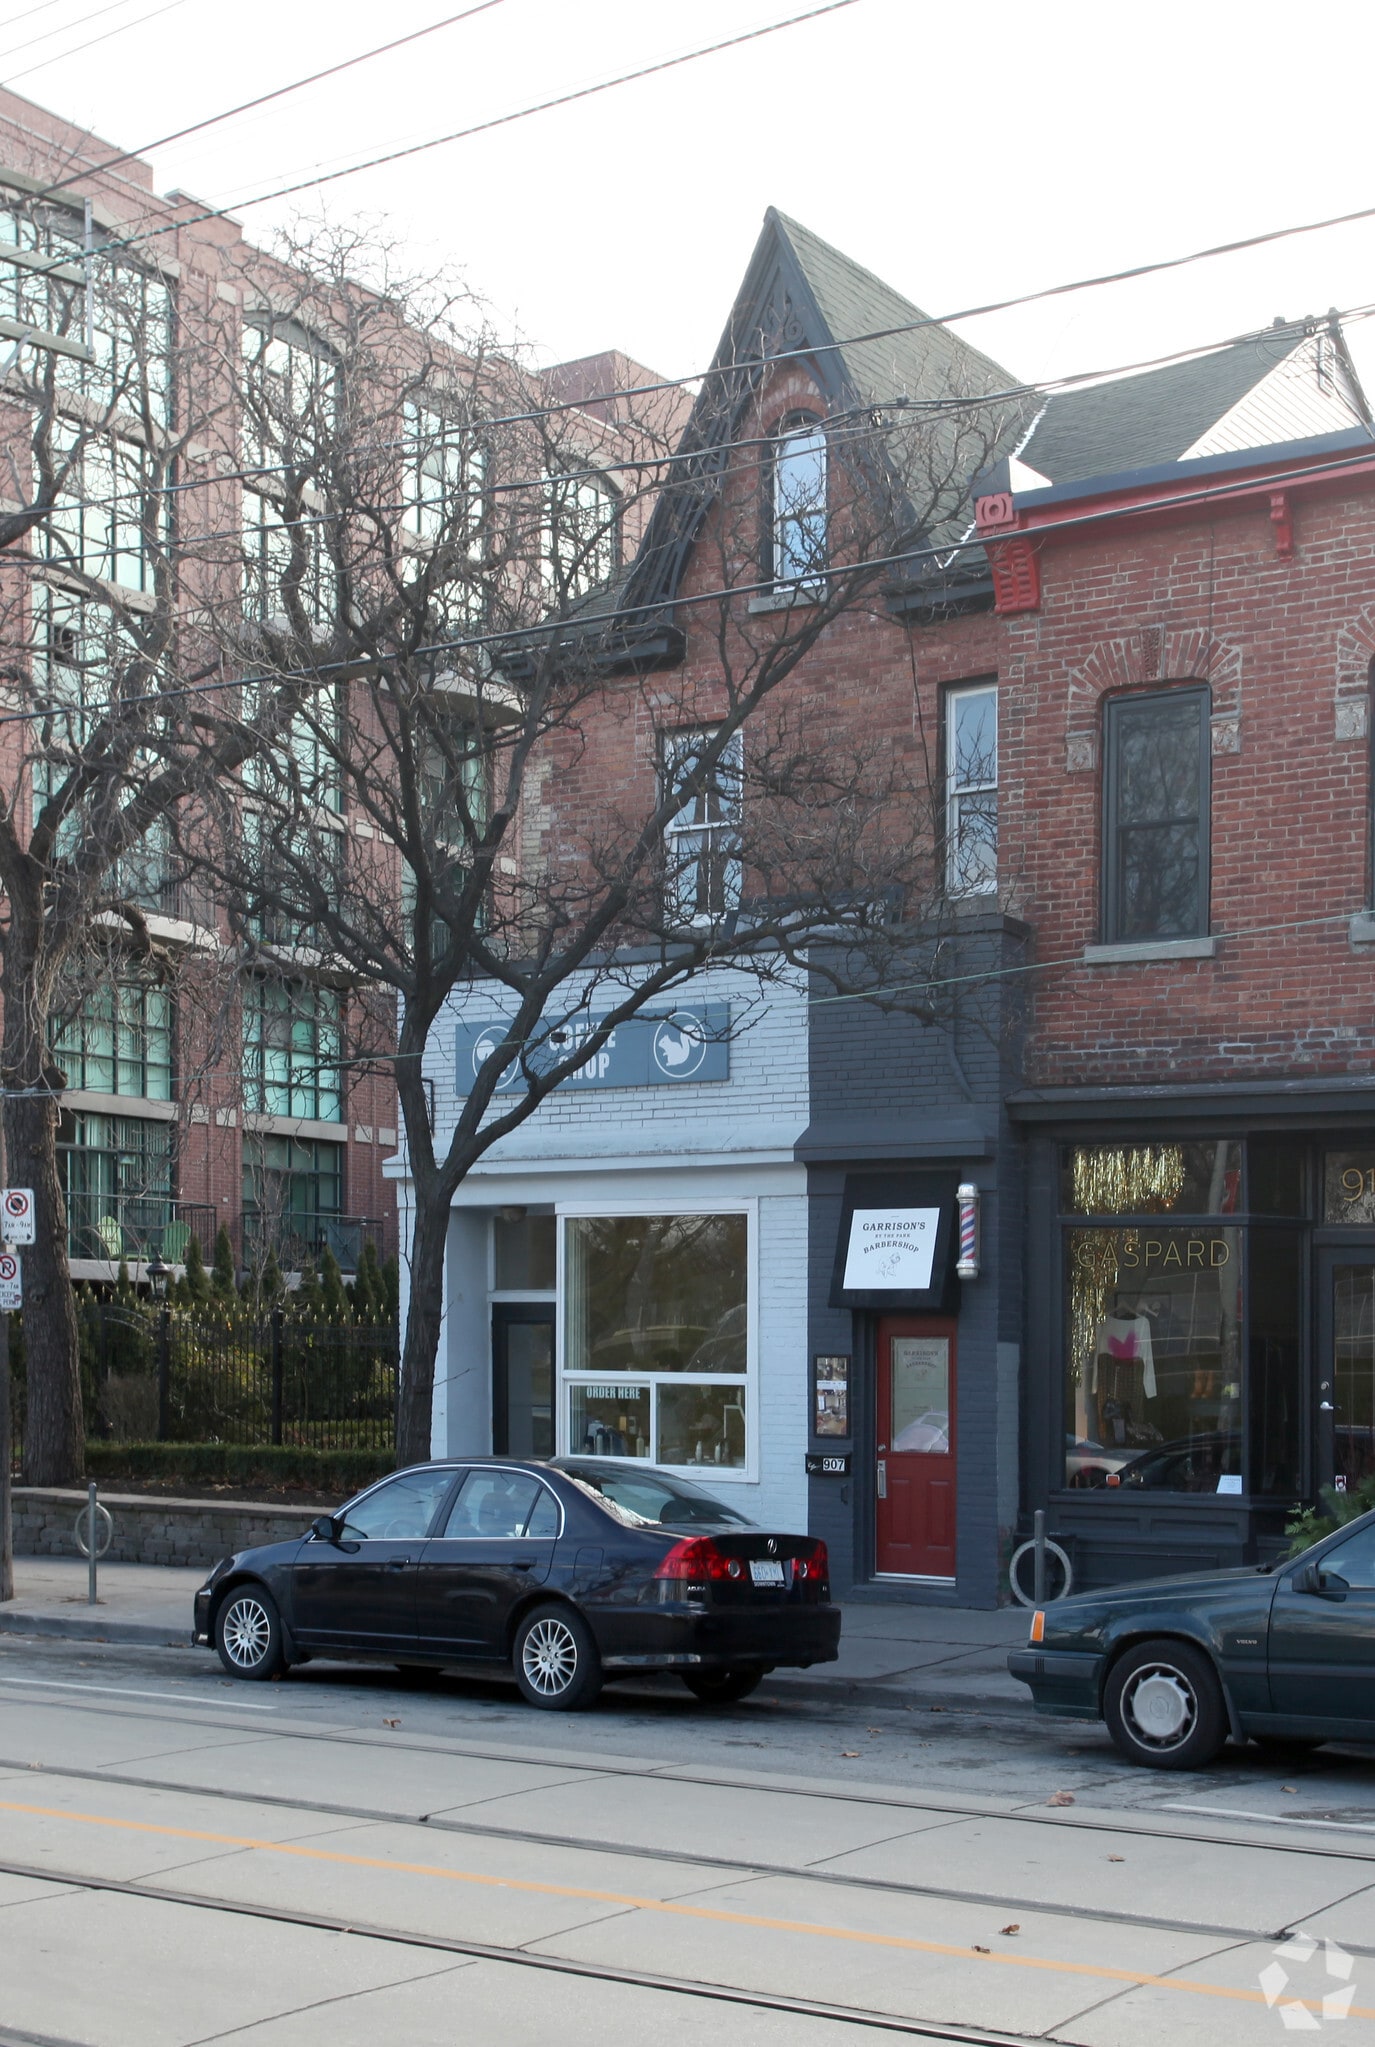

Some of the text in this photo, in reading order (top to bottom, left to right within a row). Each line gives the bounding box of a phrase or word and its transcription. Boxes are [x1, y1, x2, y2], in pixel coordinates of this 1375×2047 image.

[549, 1021, 616, 1051] COFE
[862, 1221, 926, 1231] GARRISON'S
[863, 1240, 919, 1254] BARBERSHOP
[1077, 1239, 1230, 1267] GASPARD
[586, 1385, 640, 1400] ORDER HERE
[823, 1459, 844, 1470] 907
